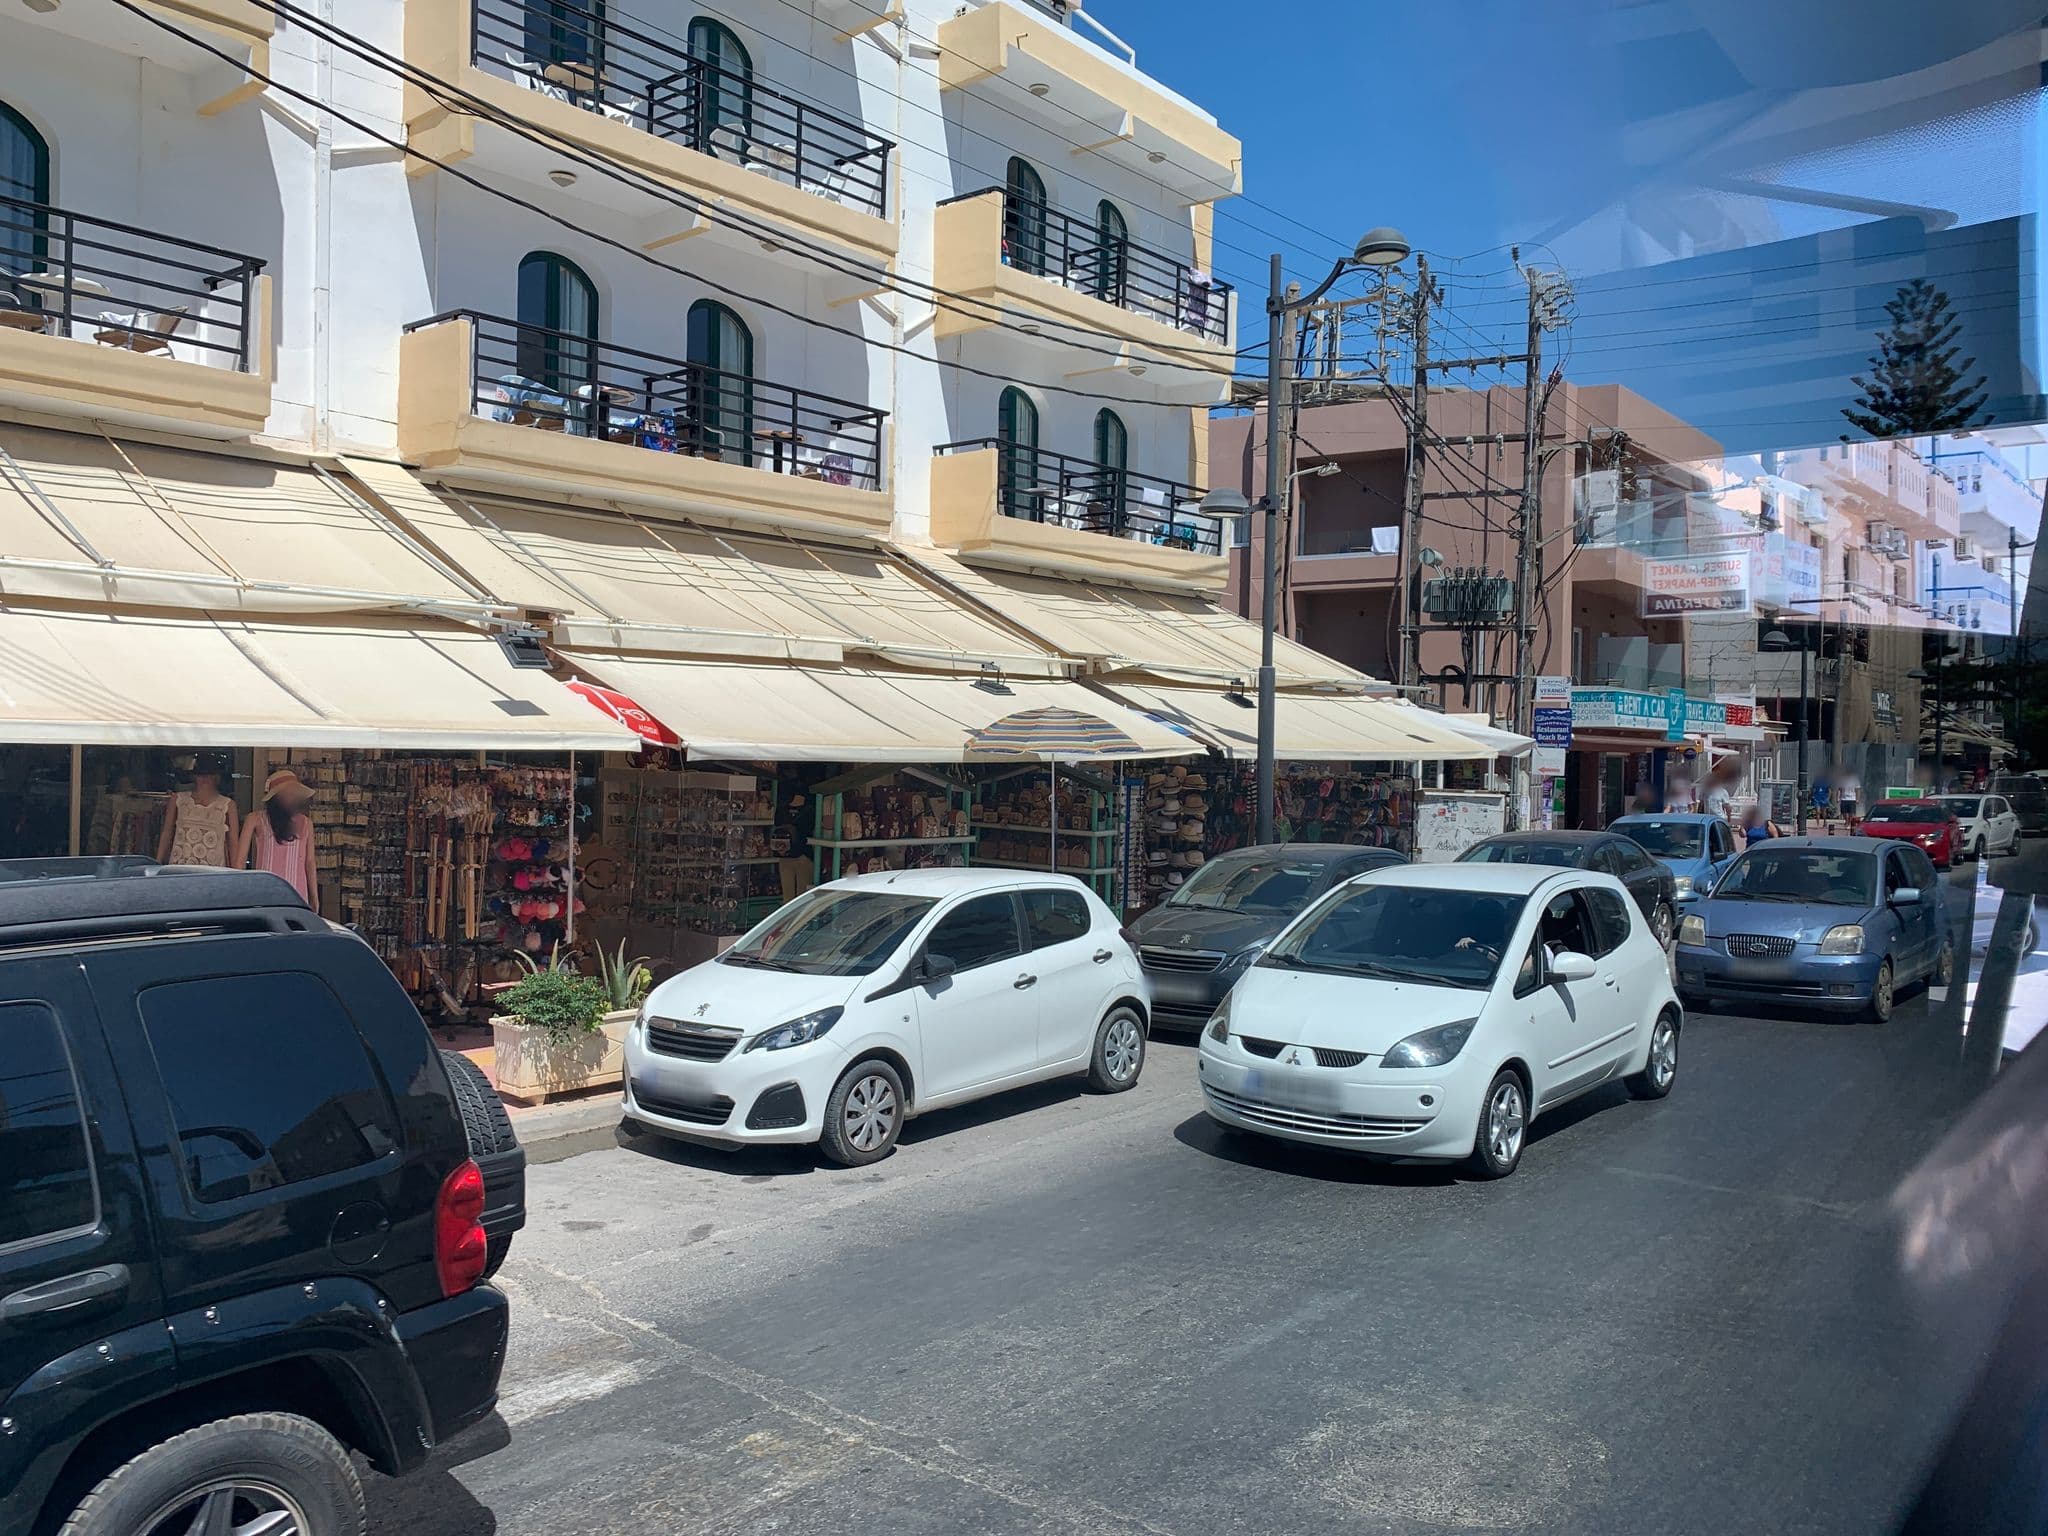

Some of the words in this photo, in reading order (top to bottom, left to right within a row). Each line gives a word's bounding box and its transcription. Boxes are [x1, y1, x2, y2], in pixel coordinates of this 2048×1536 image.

[1623, 695, 1642, 715] RENT
[1643, 697, 1649, 716] A
[1651, 698, 1665, 717] CAR
[1685, 702, 1704, 720] TRAVEL
[1538, 733, 1556, 741] Beach
[1557, 733, 1568, 741] Bar
